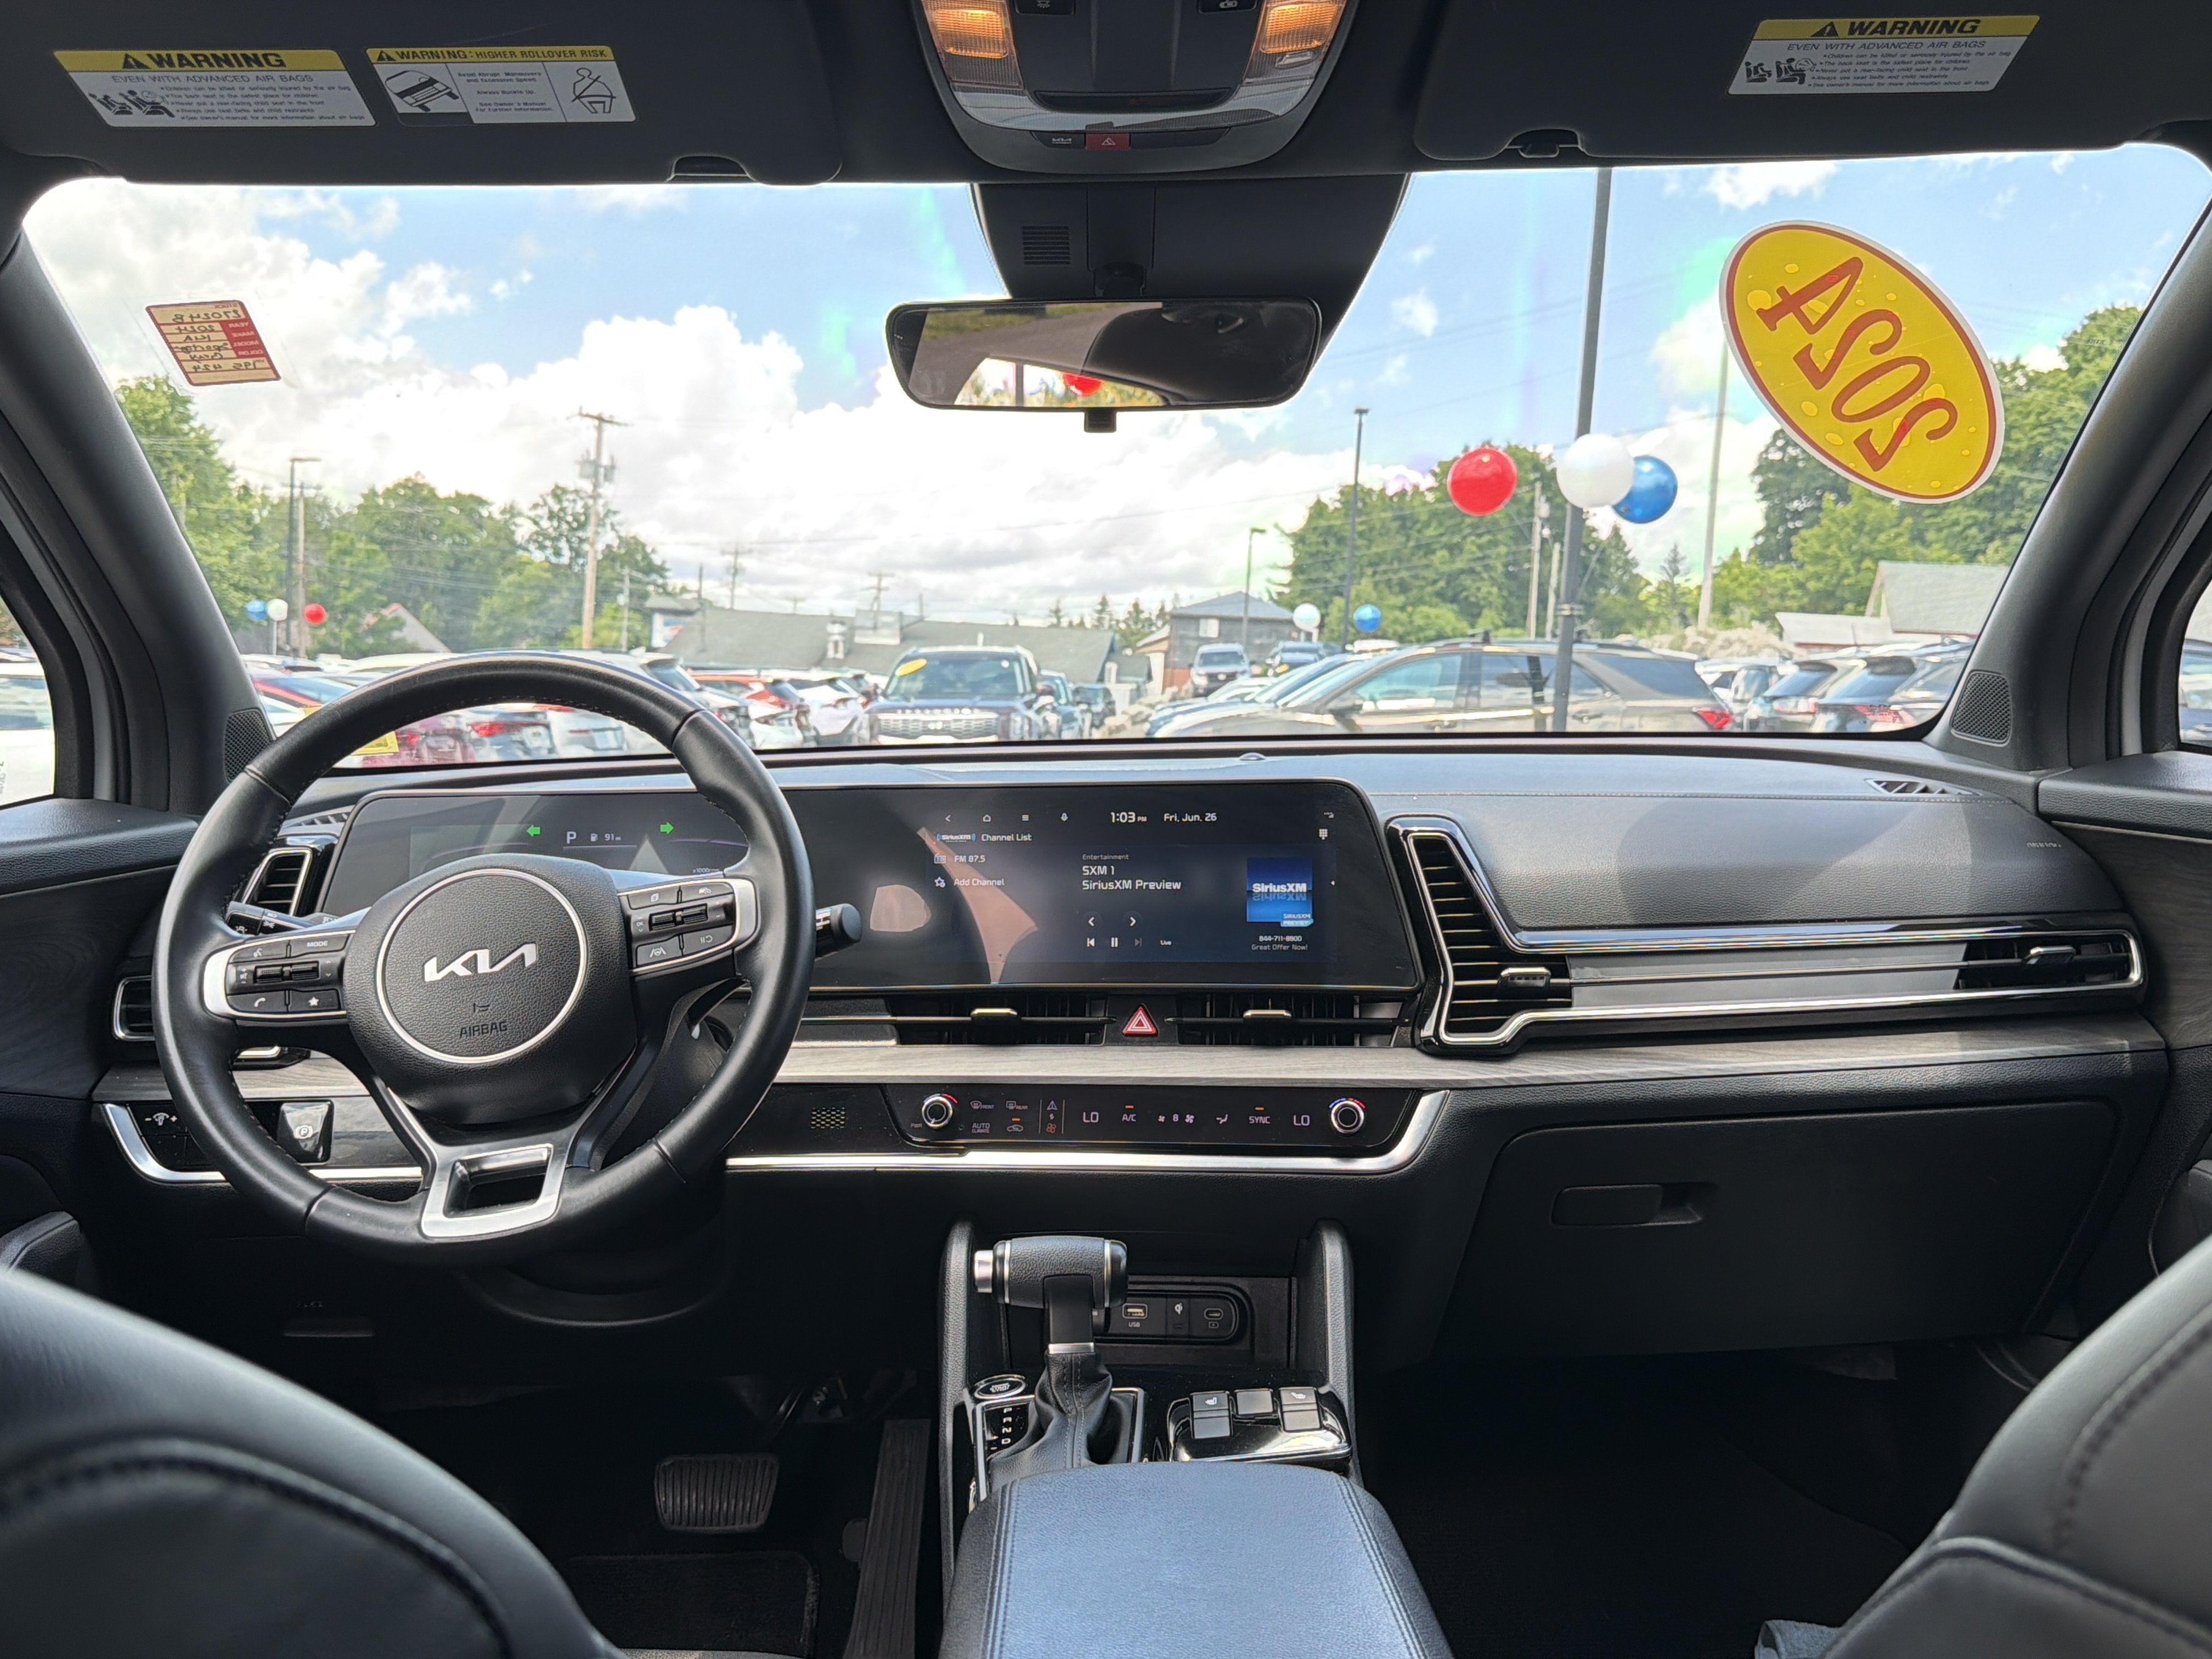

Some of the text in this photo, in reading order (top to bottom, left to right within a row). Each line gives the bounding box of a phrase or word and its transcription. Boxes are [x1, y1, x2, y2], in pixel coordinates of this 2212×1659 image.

[1848, 19, 1980, 36] WARNING
[1787, 40, 1986, 52] EVEN WITH ADVANCED AIR BAGS
[396, 49, 607, 60] WARNING: HIGHER ROLLOVER RISK
[145, 53, 287, 69] WARNING
[150, 75, 182, 83] WITH
[185, 75, 250, 83] ADVANCED
[255, 75, 275, 83] AIR
[280, 74, 314, 83] BAGS
[1110, 811, 1136, 823] 1:03
[1182, 812, 1203, 823] Jun.
[1205, 812, 1217, 822] 26
[566, 831, 577, 844] P
[981, 833, 1014, 842] Channel
[1017, 833, 1032, 842] List
[968, 855, 986, 863] 87.5
[1082, 865, 1115, 876] SXM 1
[972, 878, 1005, 886] Channel
[1082, 879, 1182, 890] SiriusXM Preview
[1252, 882, 1307, 893] SiriusXM
[459, 1020, 508, 1038] AIRBAG
[1082, 1111, 1099, 1124] LO
[1121, 1114, 1137, 1122] A/C
[1172, 1114, 1179, 1122] 8
[1249, 1115, 1271, 1124] SYNC
[1293, 1114, 1310, 1126] LO
